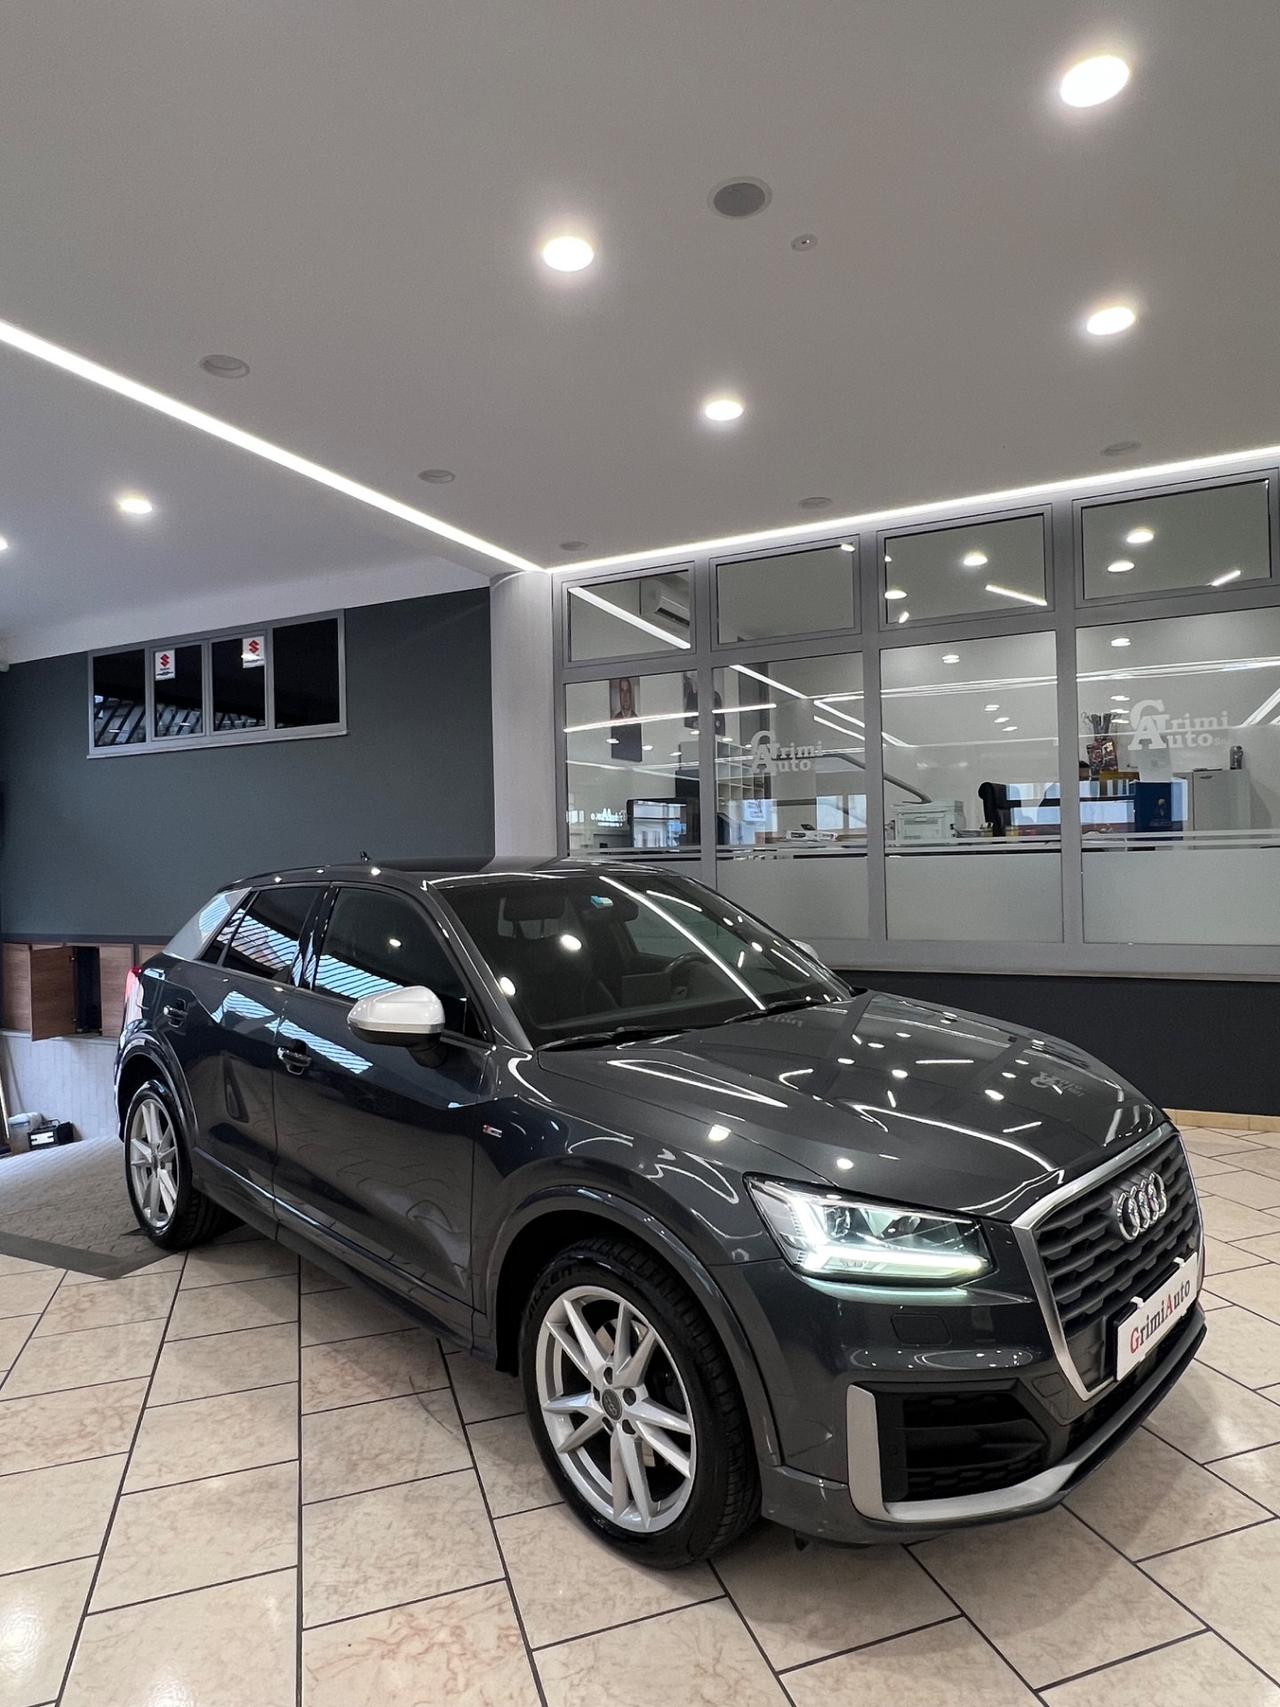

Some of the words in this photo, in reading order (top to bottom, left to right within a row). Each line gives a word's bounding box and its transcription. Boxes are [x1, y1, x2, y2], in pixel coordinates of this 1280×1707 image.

[1130, 699, 1229, 732] Grimi
[751, 730, 822, 758] Grimi
[1128, 716, 1214, 750] Auto
[752, 744, 811, 776] Auto
[1130, 1279, 1191, 1354] GrimiAuto
